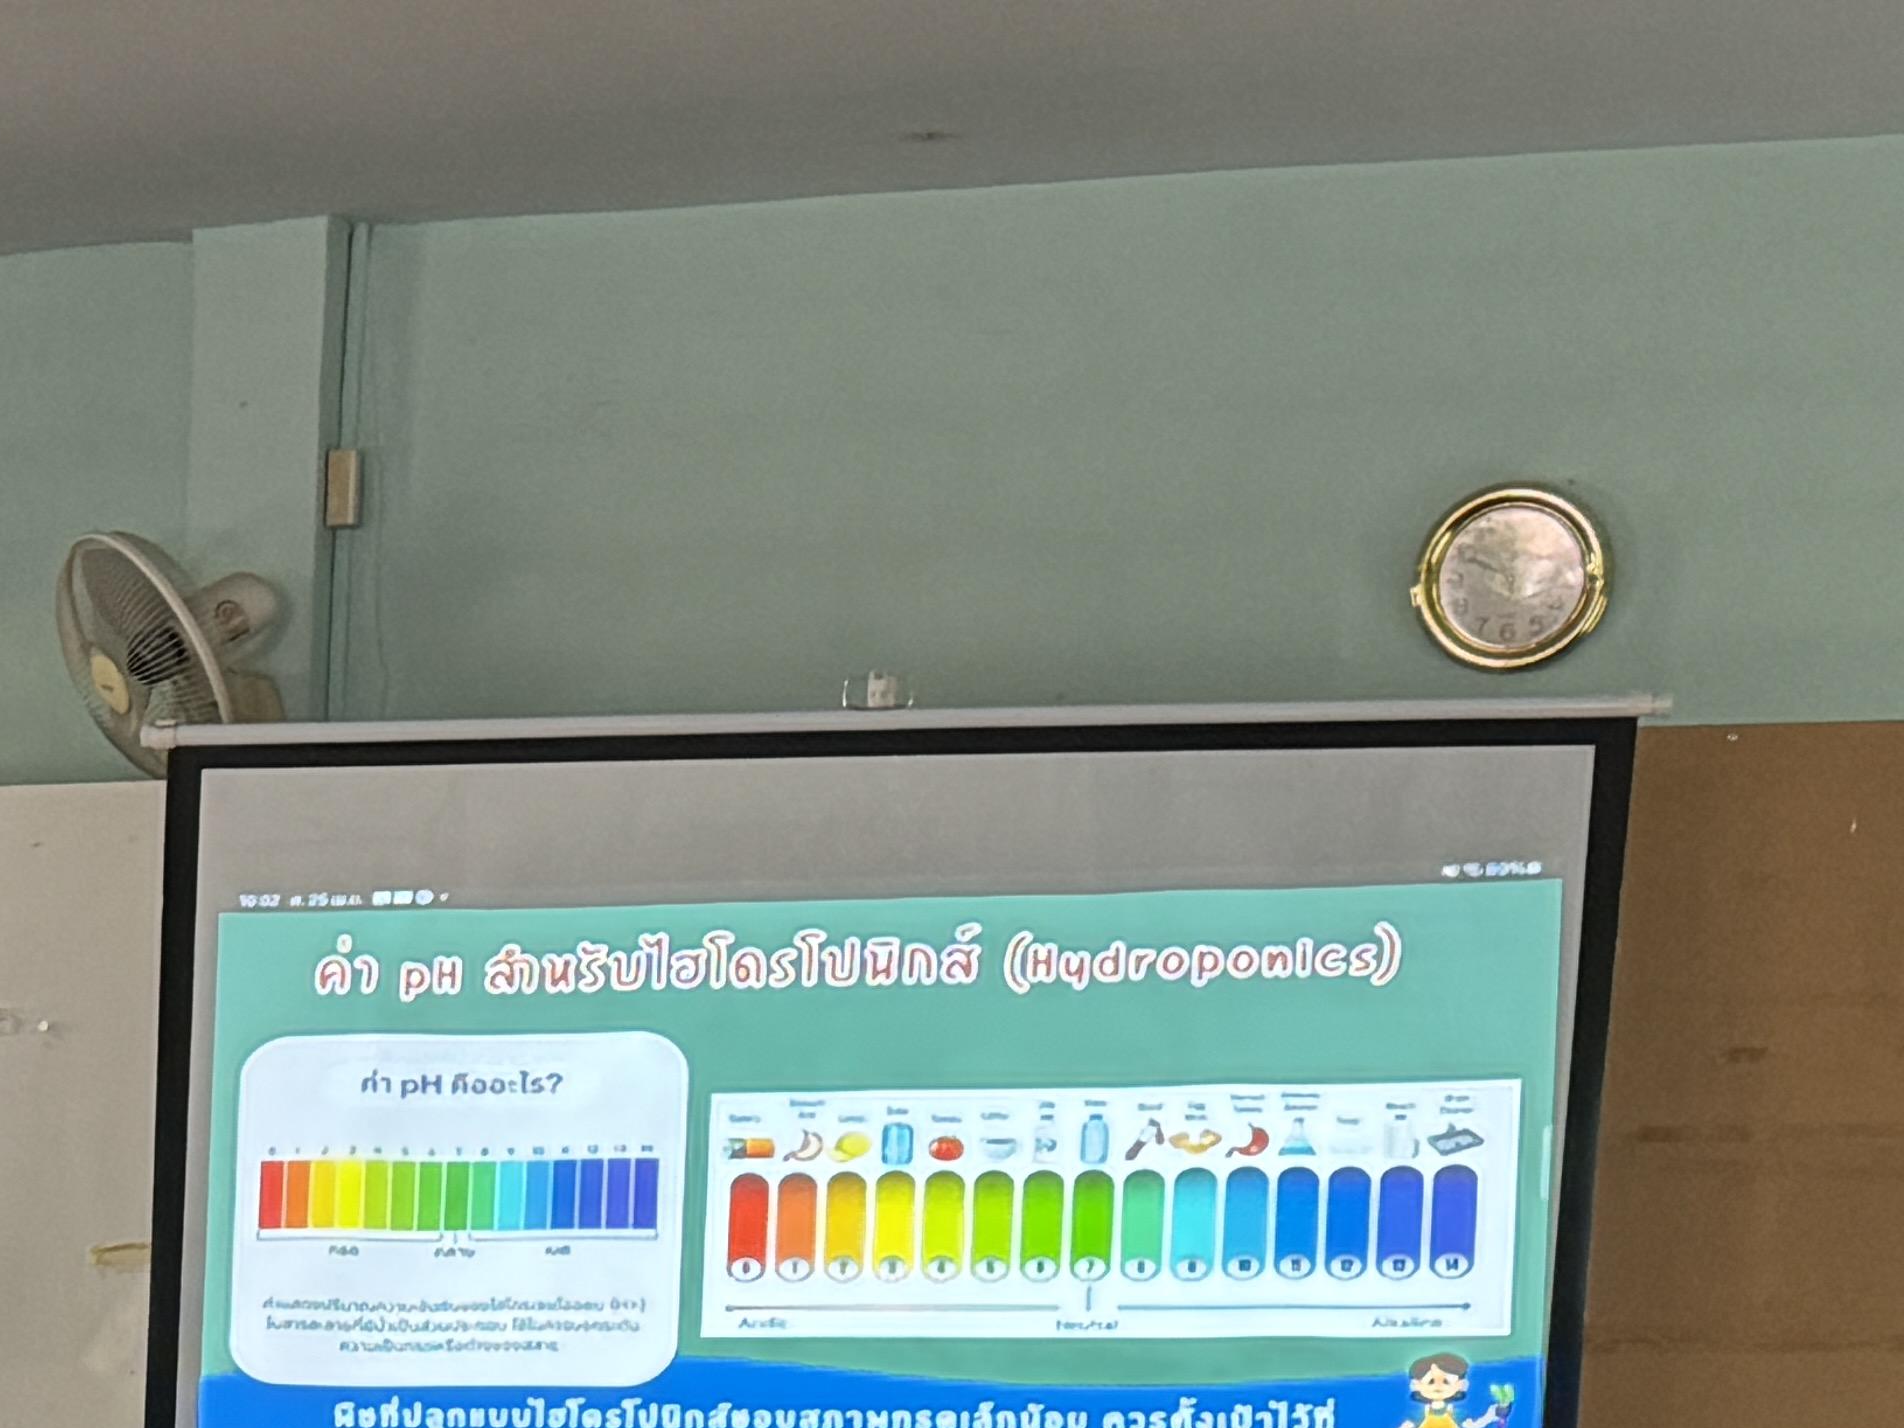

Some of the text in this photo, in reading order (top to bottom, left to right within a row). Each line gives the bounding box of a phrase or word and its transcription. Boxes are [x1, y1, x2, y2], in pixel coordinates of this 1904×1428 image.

[315, 922, 1402, 1003] ค่า pH สำหรับไฮโดรโปนิกส์ (Hydroponics)
[401, 1072, 442, 1098] pH
